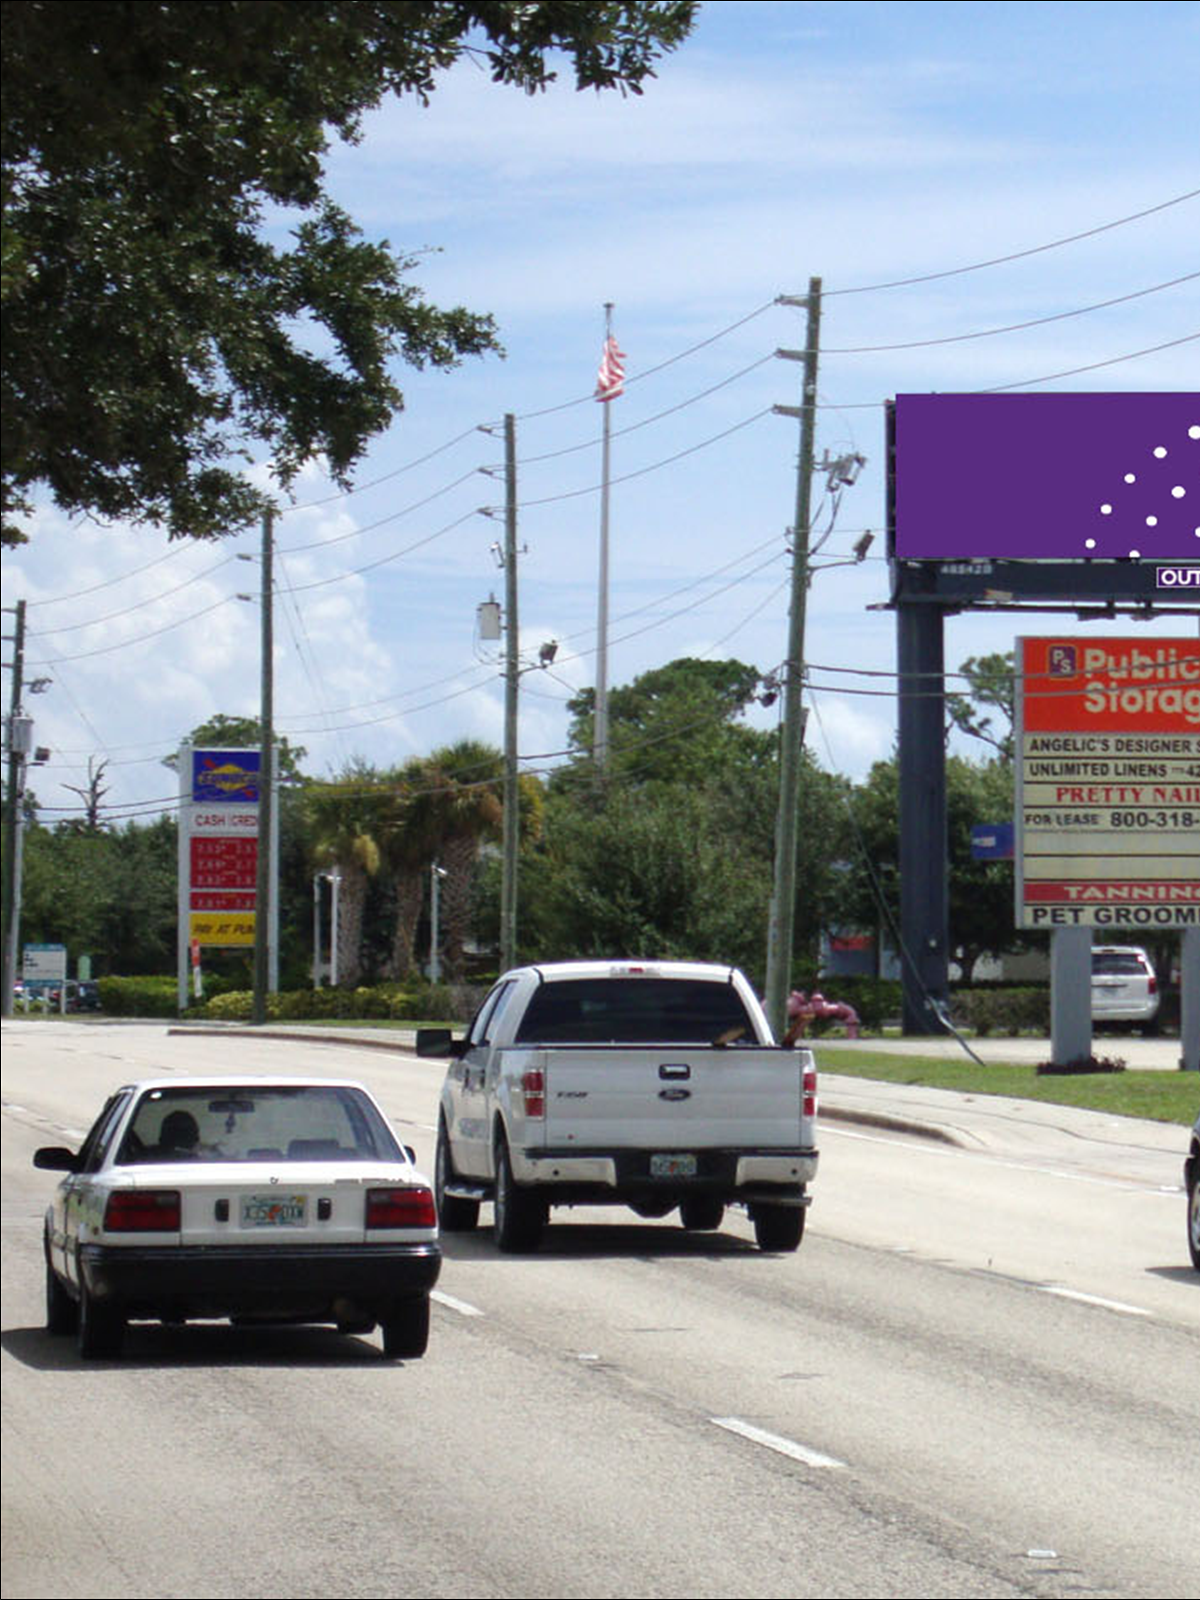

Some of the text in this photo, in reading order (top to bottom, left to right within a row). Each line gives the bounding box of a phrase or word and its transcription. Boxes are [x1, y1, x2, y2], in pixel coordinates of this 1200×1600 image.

[1084, 648, 1200, 679] Public
[1029, 739, 1110, 752] ANGELIC'S
[1115, 740, 1191, 753] DESIGNER
[1029, 763, 1109, 776] UNLIMITED
[1114, 763, 1167, 776] LINENS
[1056, 787, 1145, 802] PRETTY
[195, 814, 225, 827] CASH
[1025, 814, 1051, 825] FOR
[1056, 814, 1098, 826] LEASE
[1033, 908, 1083, 923] PET
